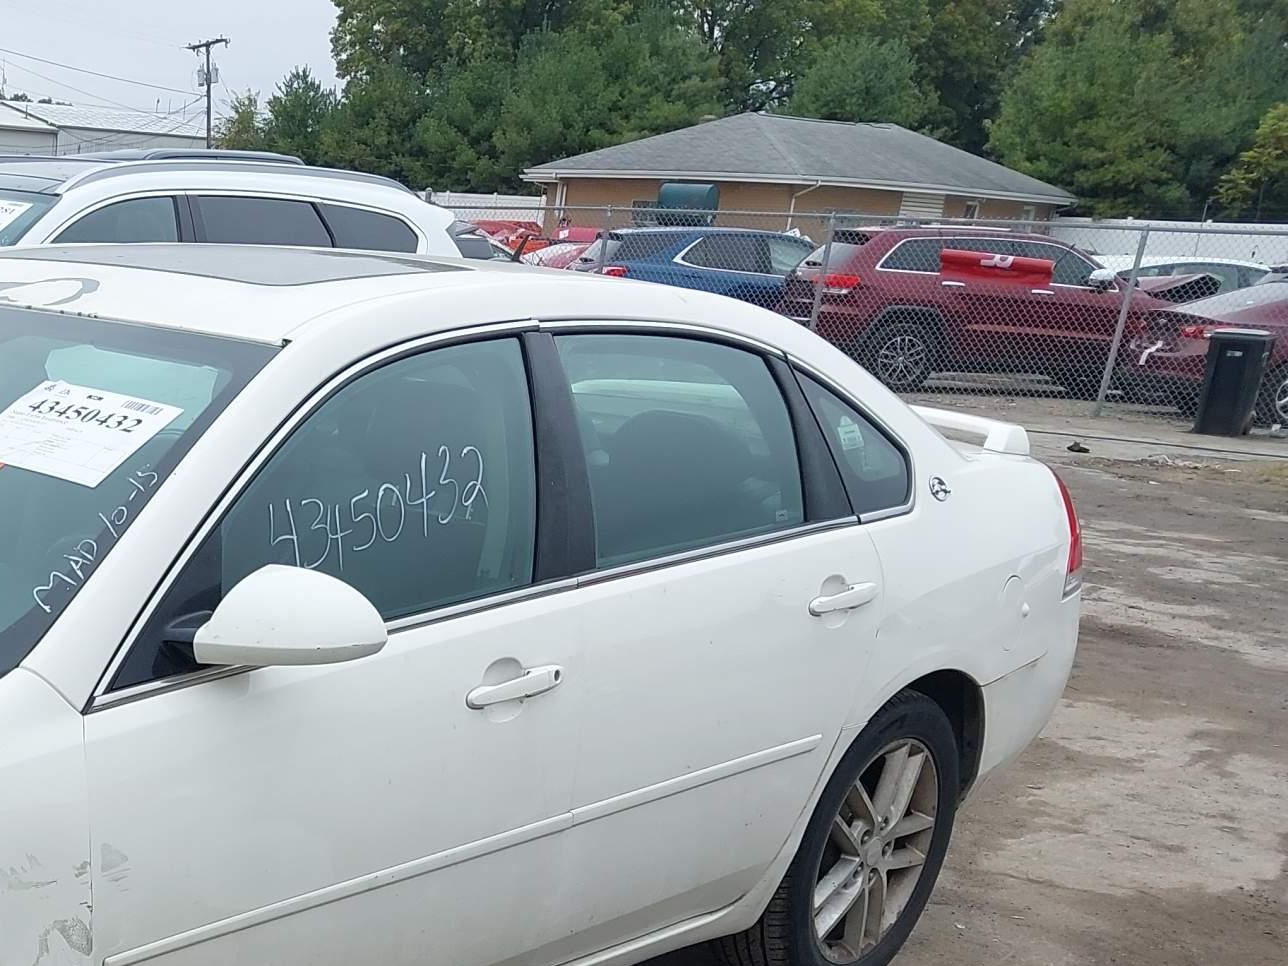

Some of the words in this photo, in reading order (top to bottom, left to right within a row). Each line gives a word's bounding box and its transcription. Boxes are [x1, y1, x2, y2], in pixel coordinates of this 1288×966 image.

[28, 398, 144, 433] 43450432
[32, 539, 98, 614] MAD
[98, 463, 159, 539] 10-15
[268, 445, 490, 571] 43450432
